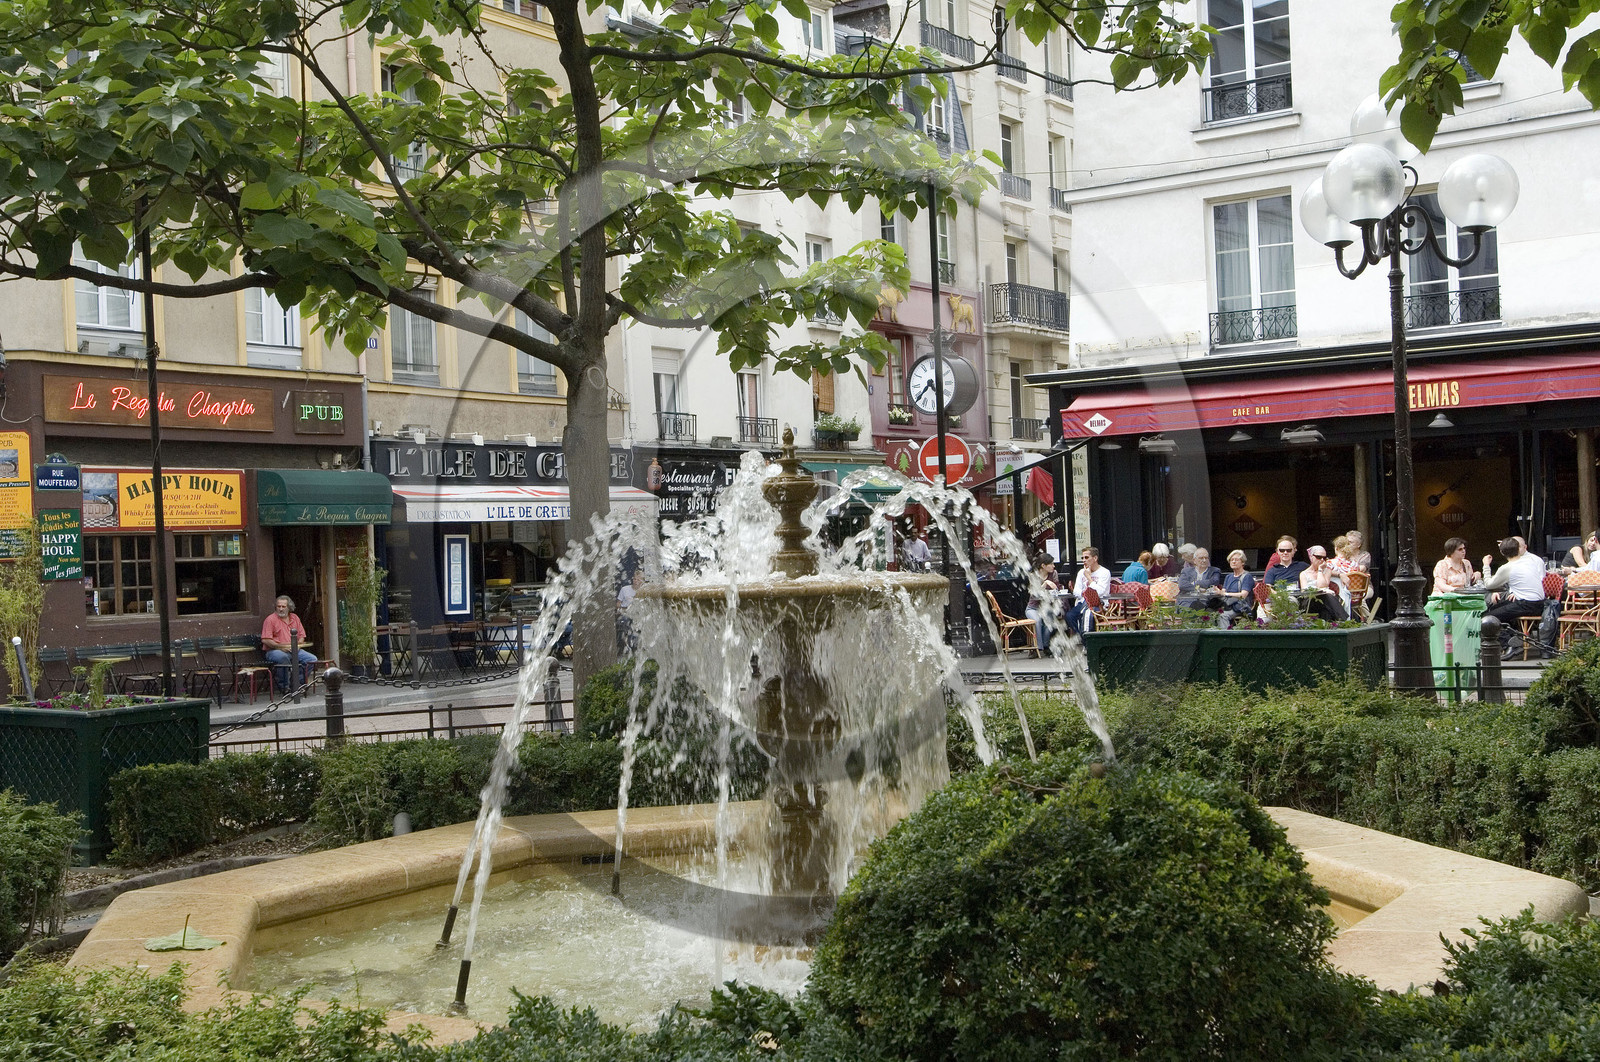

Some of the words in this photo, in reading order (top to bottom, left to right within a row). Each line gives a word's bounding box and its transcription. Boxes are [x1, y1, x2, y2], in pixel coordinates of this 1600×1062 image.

[1408, 381, 1460, 409] ELMAS
[70, 382, 97, 410] Le
[111, 387, 176, 419] Reqin
[187, 390, 255, 425] Chagrin
[301, 404, 344, 421] PUB
[1255, 406, 1270, 415] BAR
[1089, 419, 1106, 428] DELMAS
[389, 448, 476, 477] L'ILE
[488, 450, 528, 479] DE
[51, 469, 65, 477] RUE
[661, 468, 715, 483] estaurant
[38, 479, 78, 487] MOUFFETARD
[126, 475, 183, 500] HAPY
[189, 475, 234, 500] HOUR
[43, 513, 60, 522] Tous
[61, 511, 71, 519] les
[297, 507, 311, 520] Le
[315, 506, 350, 524] Requin
[354, 506, 388, 525] Chagrin
[487, 507, 515, 518] L'ILE
[519, 506, 532, 518] DE
[64, 520, 79, 528] Soir
[42, 533, 79, 544] HAPPY
[42, 545, 74, 556] HOUR
[44, 564, 60, 576] pour
[55, 569, 65, 579] les
[65, 565, 82, 578] filles
